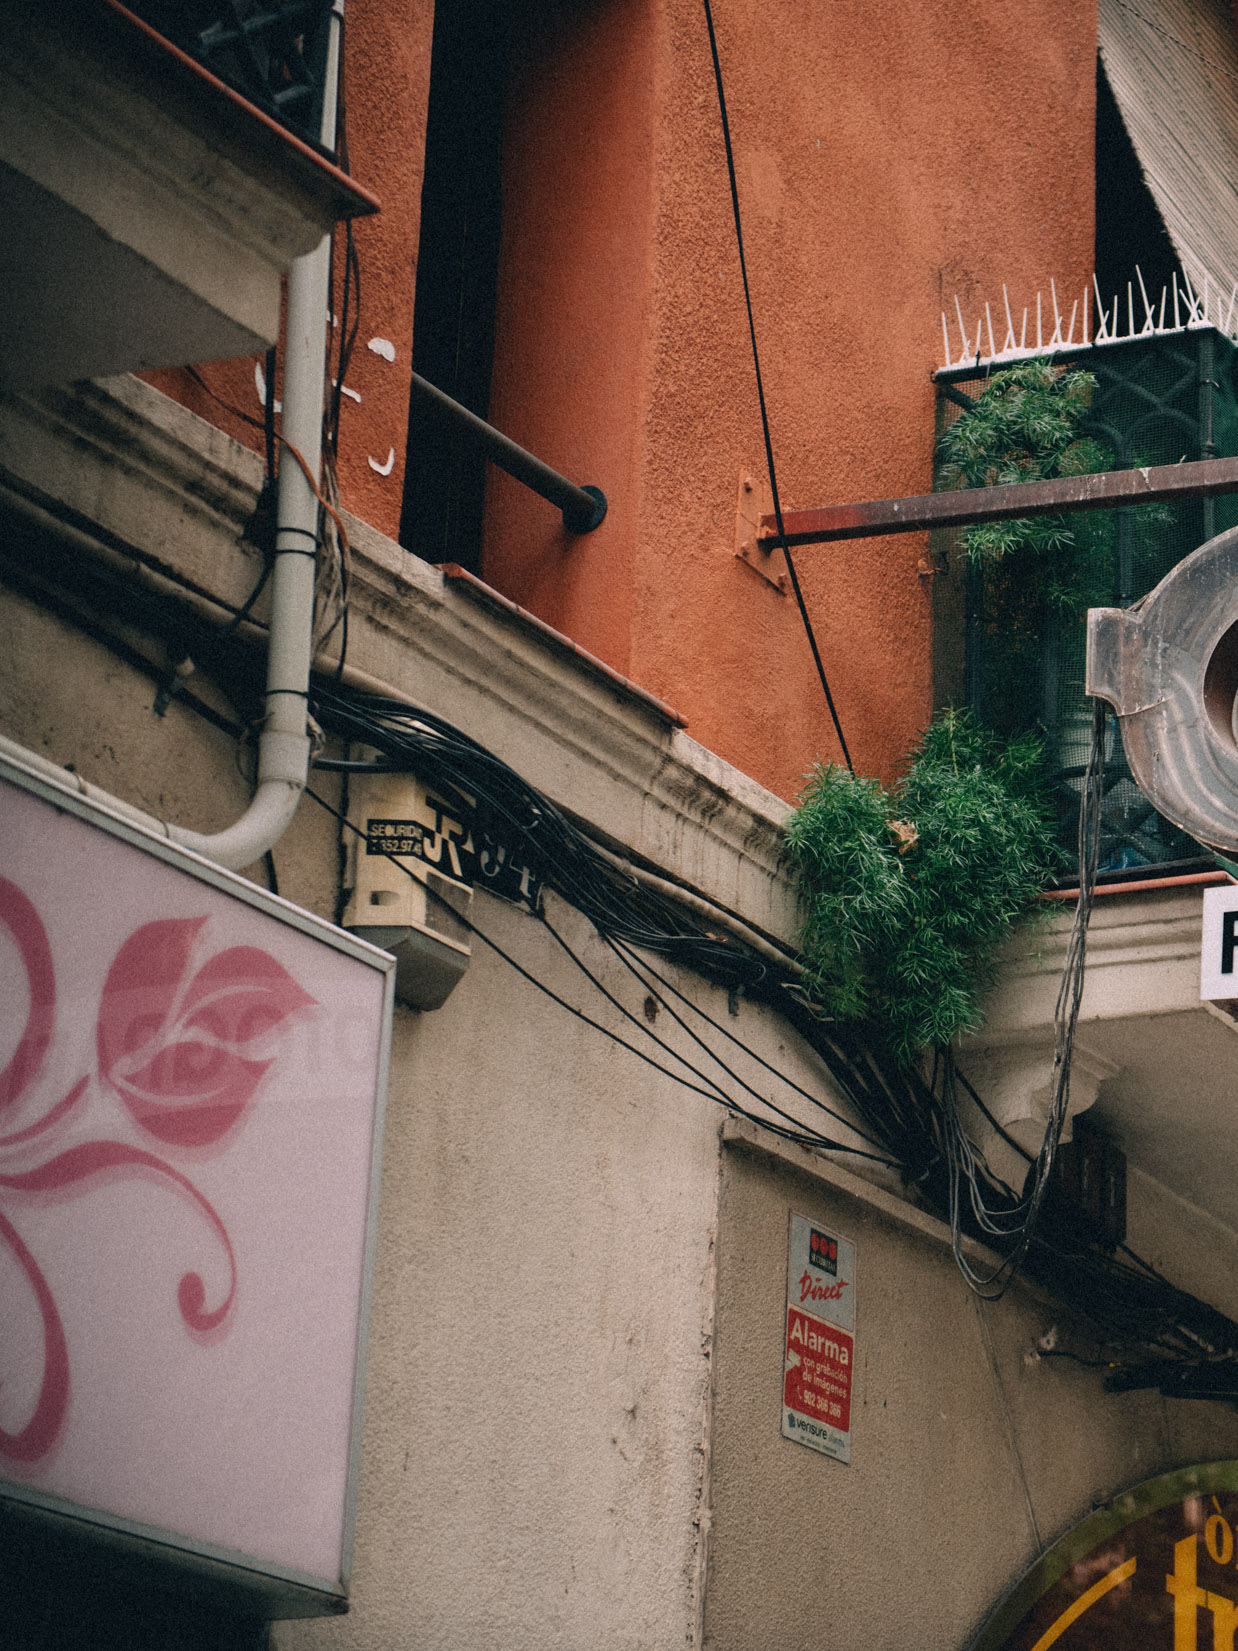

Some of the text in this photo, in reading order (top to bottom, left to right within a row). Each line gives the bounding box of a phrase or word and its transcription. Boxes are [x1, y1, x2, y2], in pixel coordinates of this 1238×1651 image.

[799, 1268, 849, 1303] Direct
[790, 1318, 849, 1365] Alarma
[802, 1371, 847, 1399] de imágenes
[797, 1418, 828, 1440] verisure
